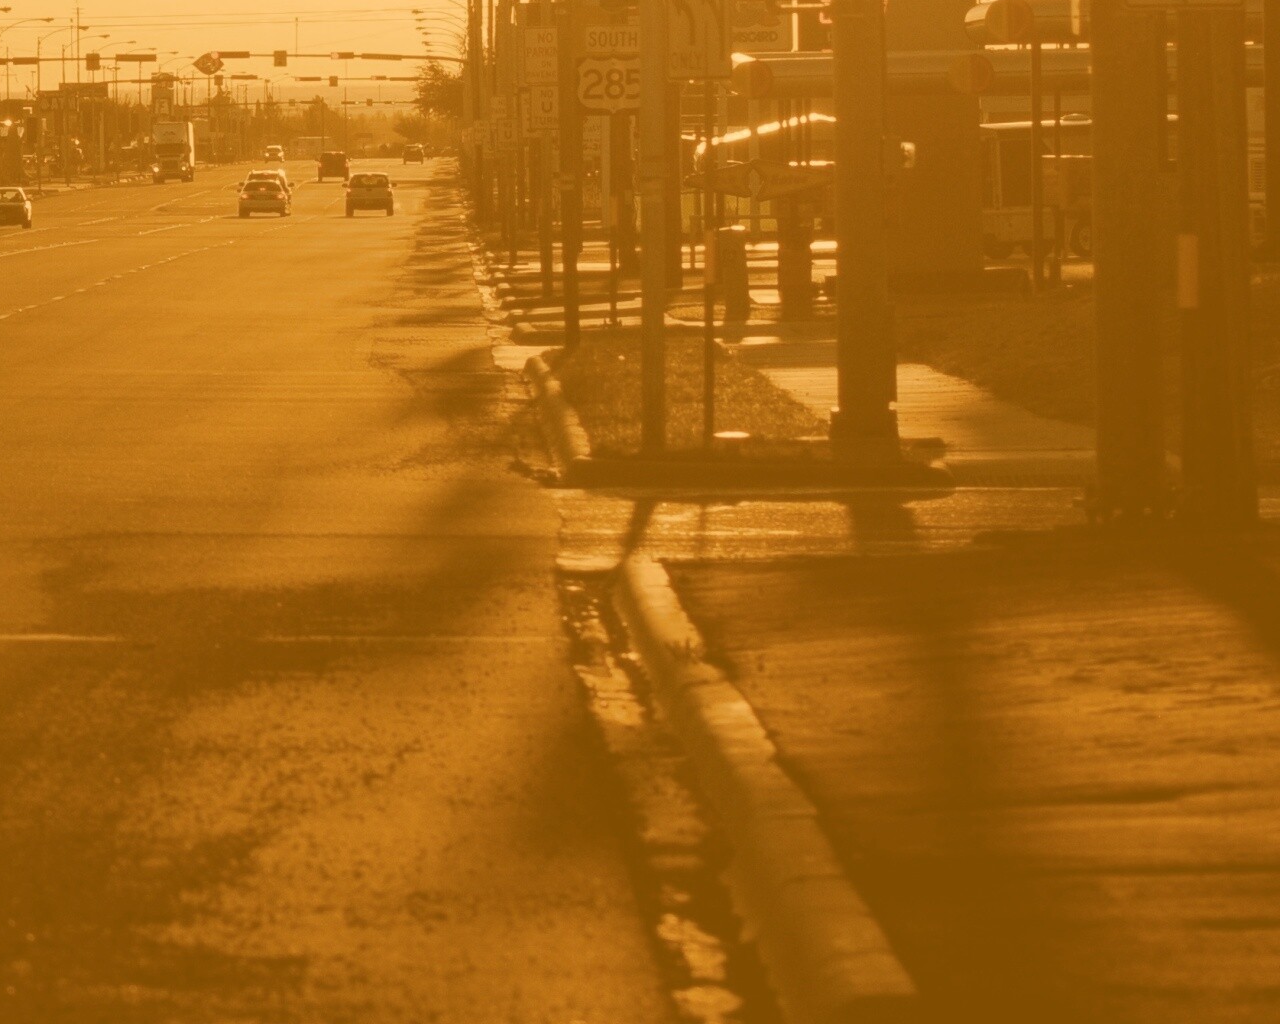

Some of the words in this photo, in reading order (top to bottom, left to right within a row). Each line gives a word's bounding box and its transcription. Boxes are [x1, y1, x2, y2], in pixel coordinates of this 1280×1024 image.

[538, 32, 553, 44] NO
[588, 31, 638, 48] SOUTH
[671, 52, 702, 70] ONLY
[582, 69, 640, 99] 285
[540, 90, 553, 98] NO
[542, 101, 552, 113] U
